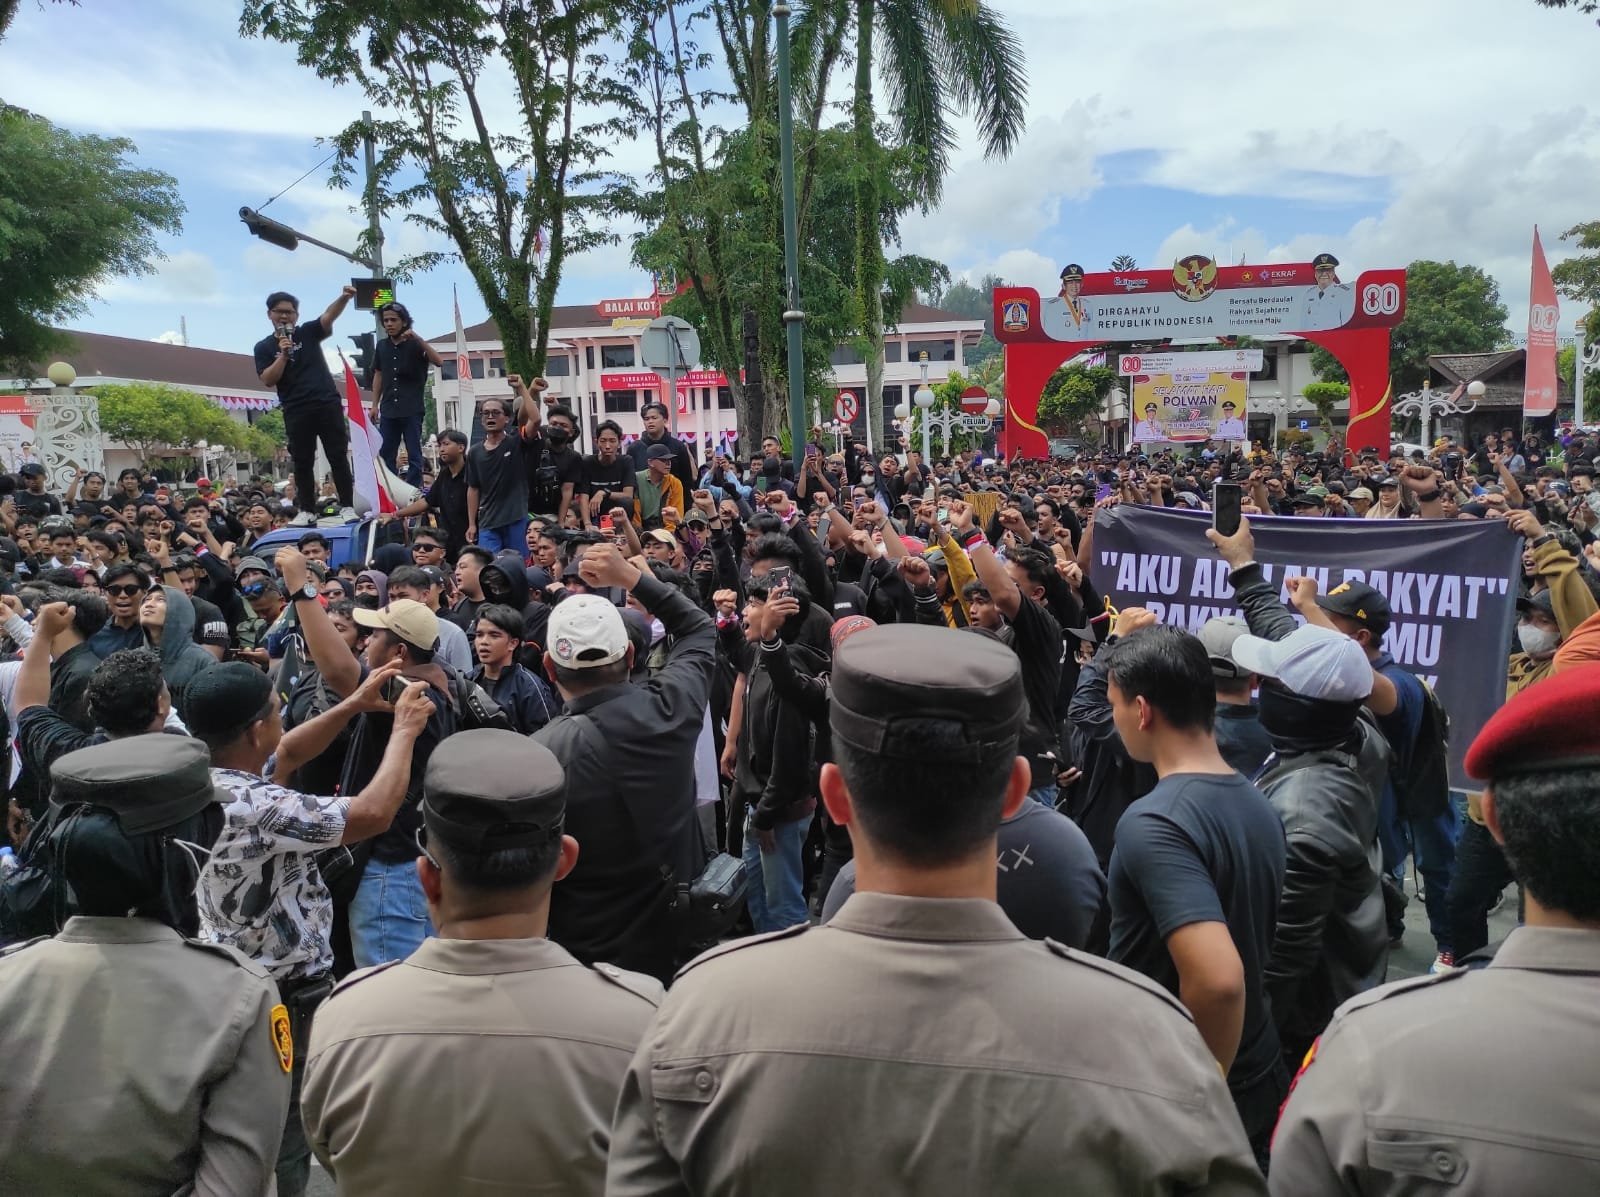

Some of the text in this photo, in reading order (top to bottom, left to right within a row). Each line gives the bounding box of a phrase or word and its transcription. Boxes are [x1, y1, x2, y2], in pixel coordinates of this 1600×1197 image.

[1258, 296, 1293, 304] Berdaulat
[1362, 283, 1400, 315] 80
[604, 301, 661, 312] BALAI KOT
[1098, 306, 1160, 316] DIRGAHAYU
[1098, 316, 1213, 329] REPUBLIK INDONESIA
[1229, 316, 1282, 326] Indonesia Maju
[1122, 356, 1141, 373] 80
[1152, 383, 1228, 395] SELAMAT HARI
[843, 397, 853, 417] P
[1163, 395, 1217, 407] POLWAN
[1300, 420, 1308, 429] P
[1101, 551, 1182, 596] "AKU
